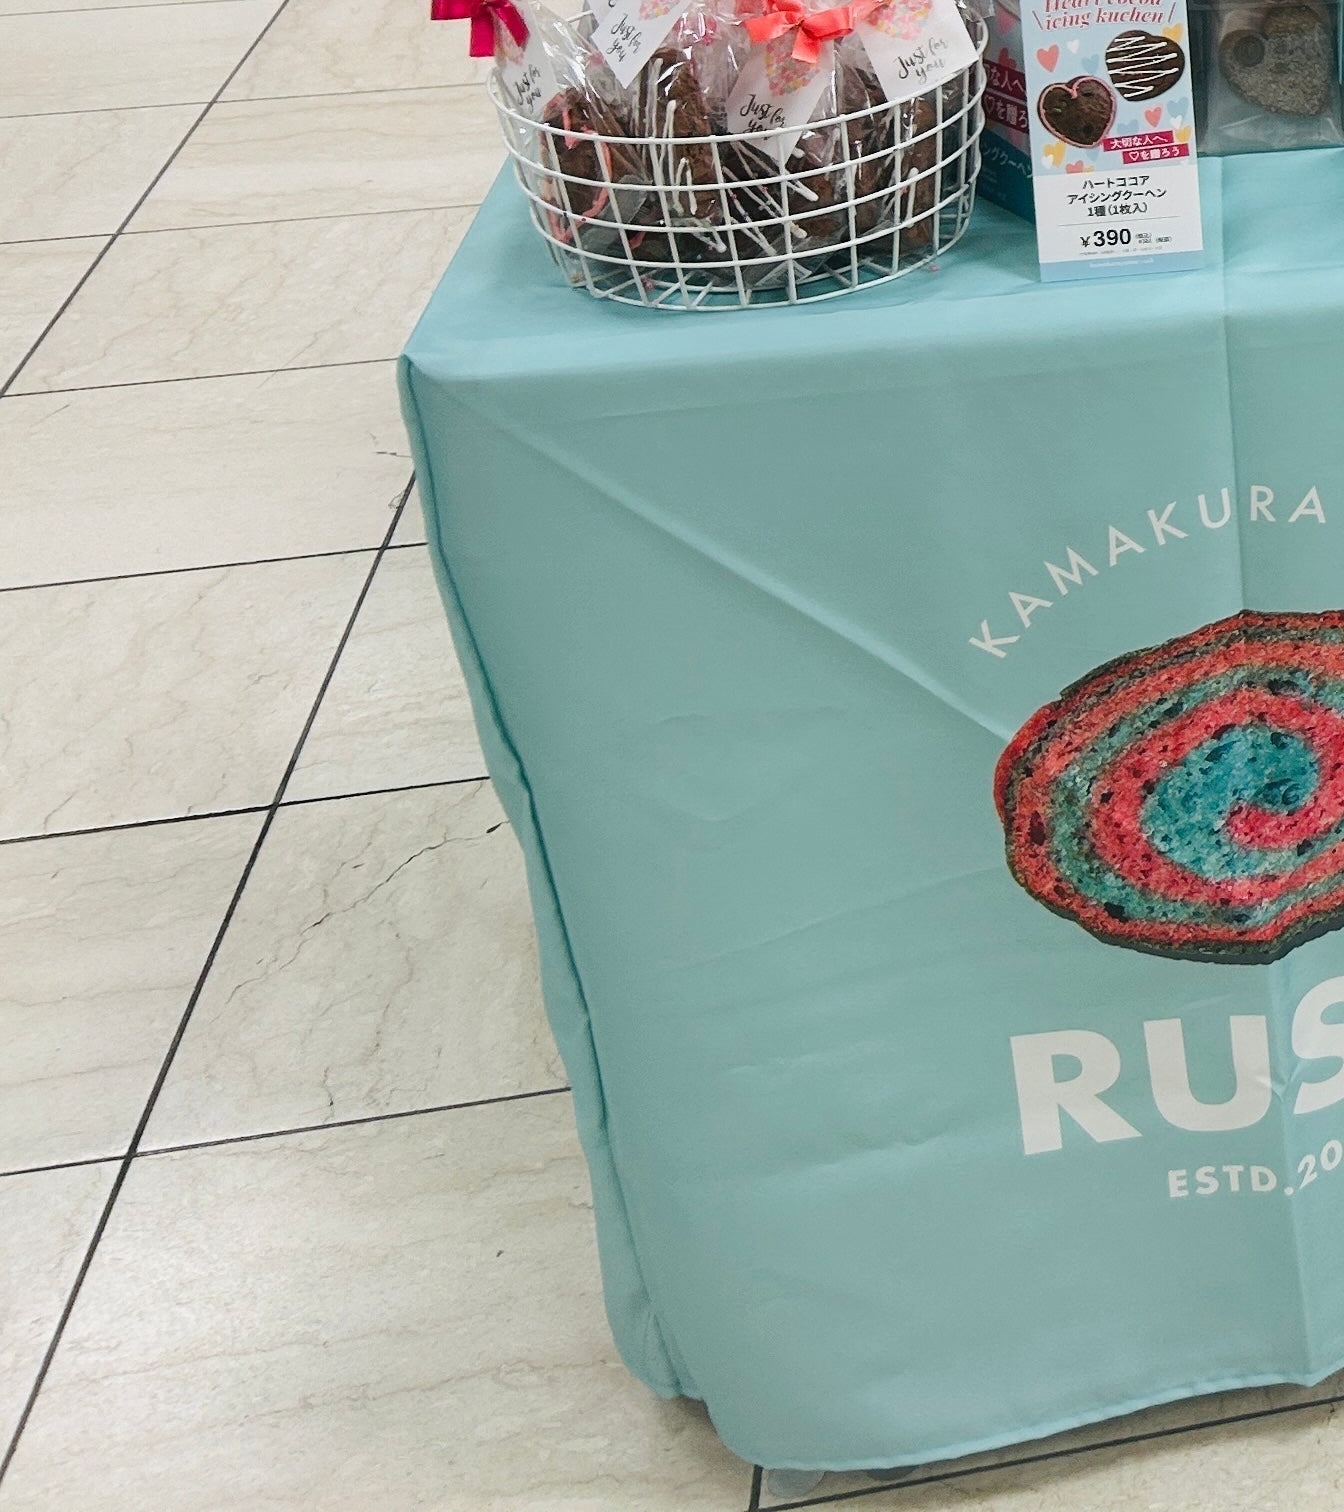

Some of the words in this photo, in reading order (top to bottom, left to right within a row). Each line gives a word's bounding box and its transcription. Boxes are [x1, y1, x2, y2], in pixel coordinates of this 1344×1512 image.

[611, 14, 635, 41] Just
[1045, 8, 1091, 31] icing
[1096, 4, 1164, 24] kuchen
[893, 46, 927, 80] Just
[514, 70, 531, 106] Just
[740, 94, 772, 120] Just
[1083, 175, 1150, 189] ハートココア
[1066, 189, 1167, 205] アイシングクーヘン
[1080, 228, 1131, 248] ¥390
